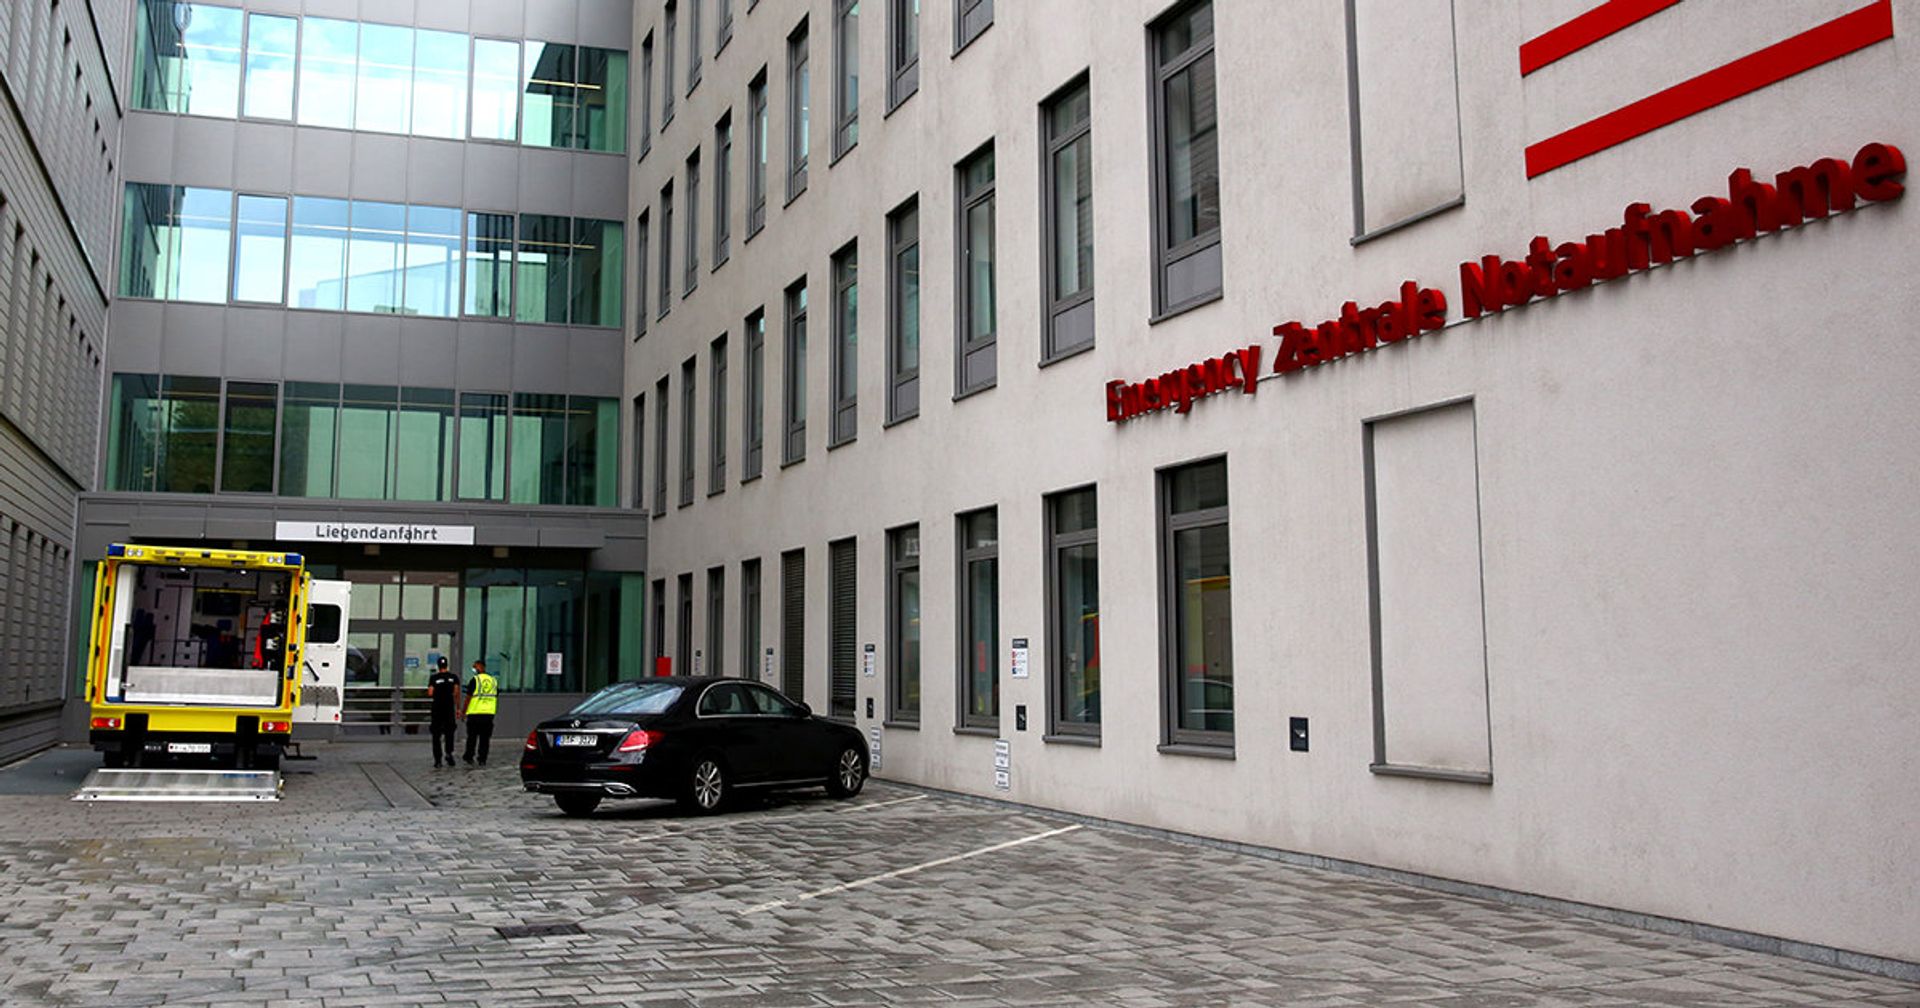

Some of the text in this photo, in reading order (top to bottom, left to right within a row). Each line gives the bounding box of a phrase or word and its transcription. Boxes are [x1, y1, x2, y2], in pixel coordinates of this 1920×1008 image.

[1106, 142, 1906, 421] Emergency Zentrale Notaufnahme
[315, 524, 438, 543] Liegendanfahrt
